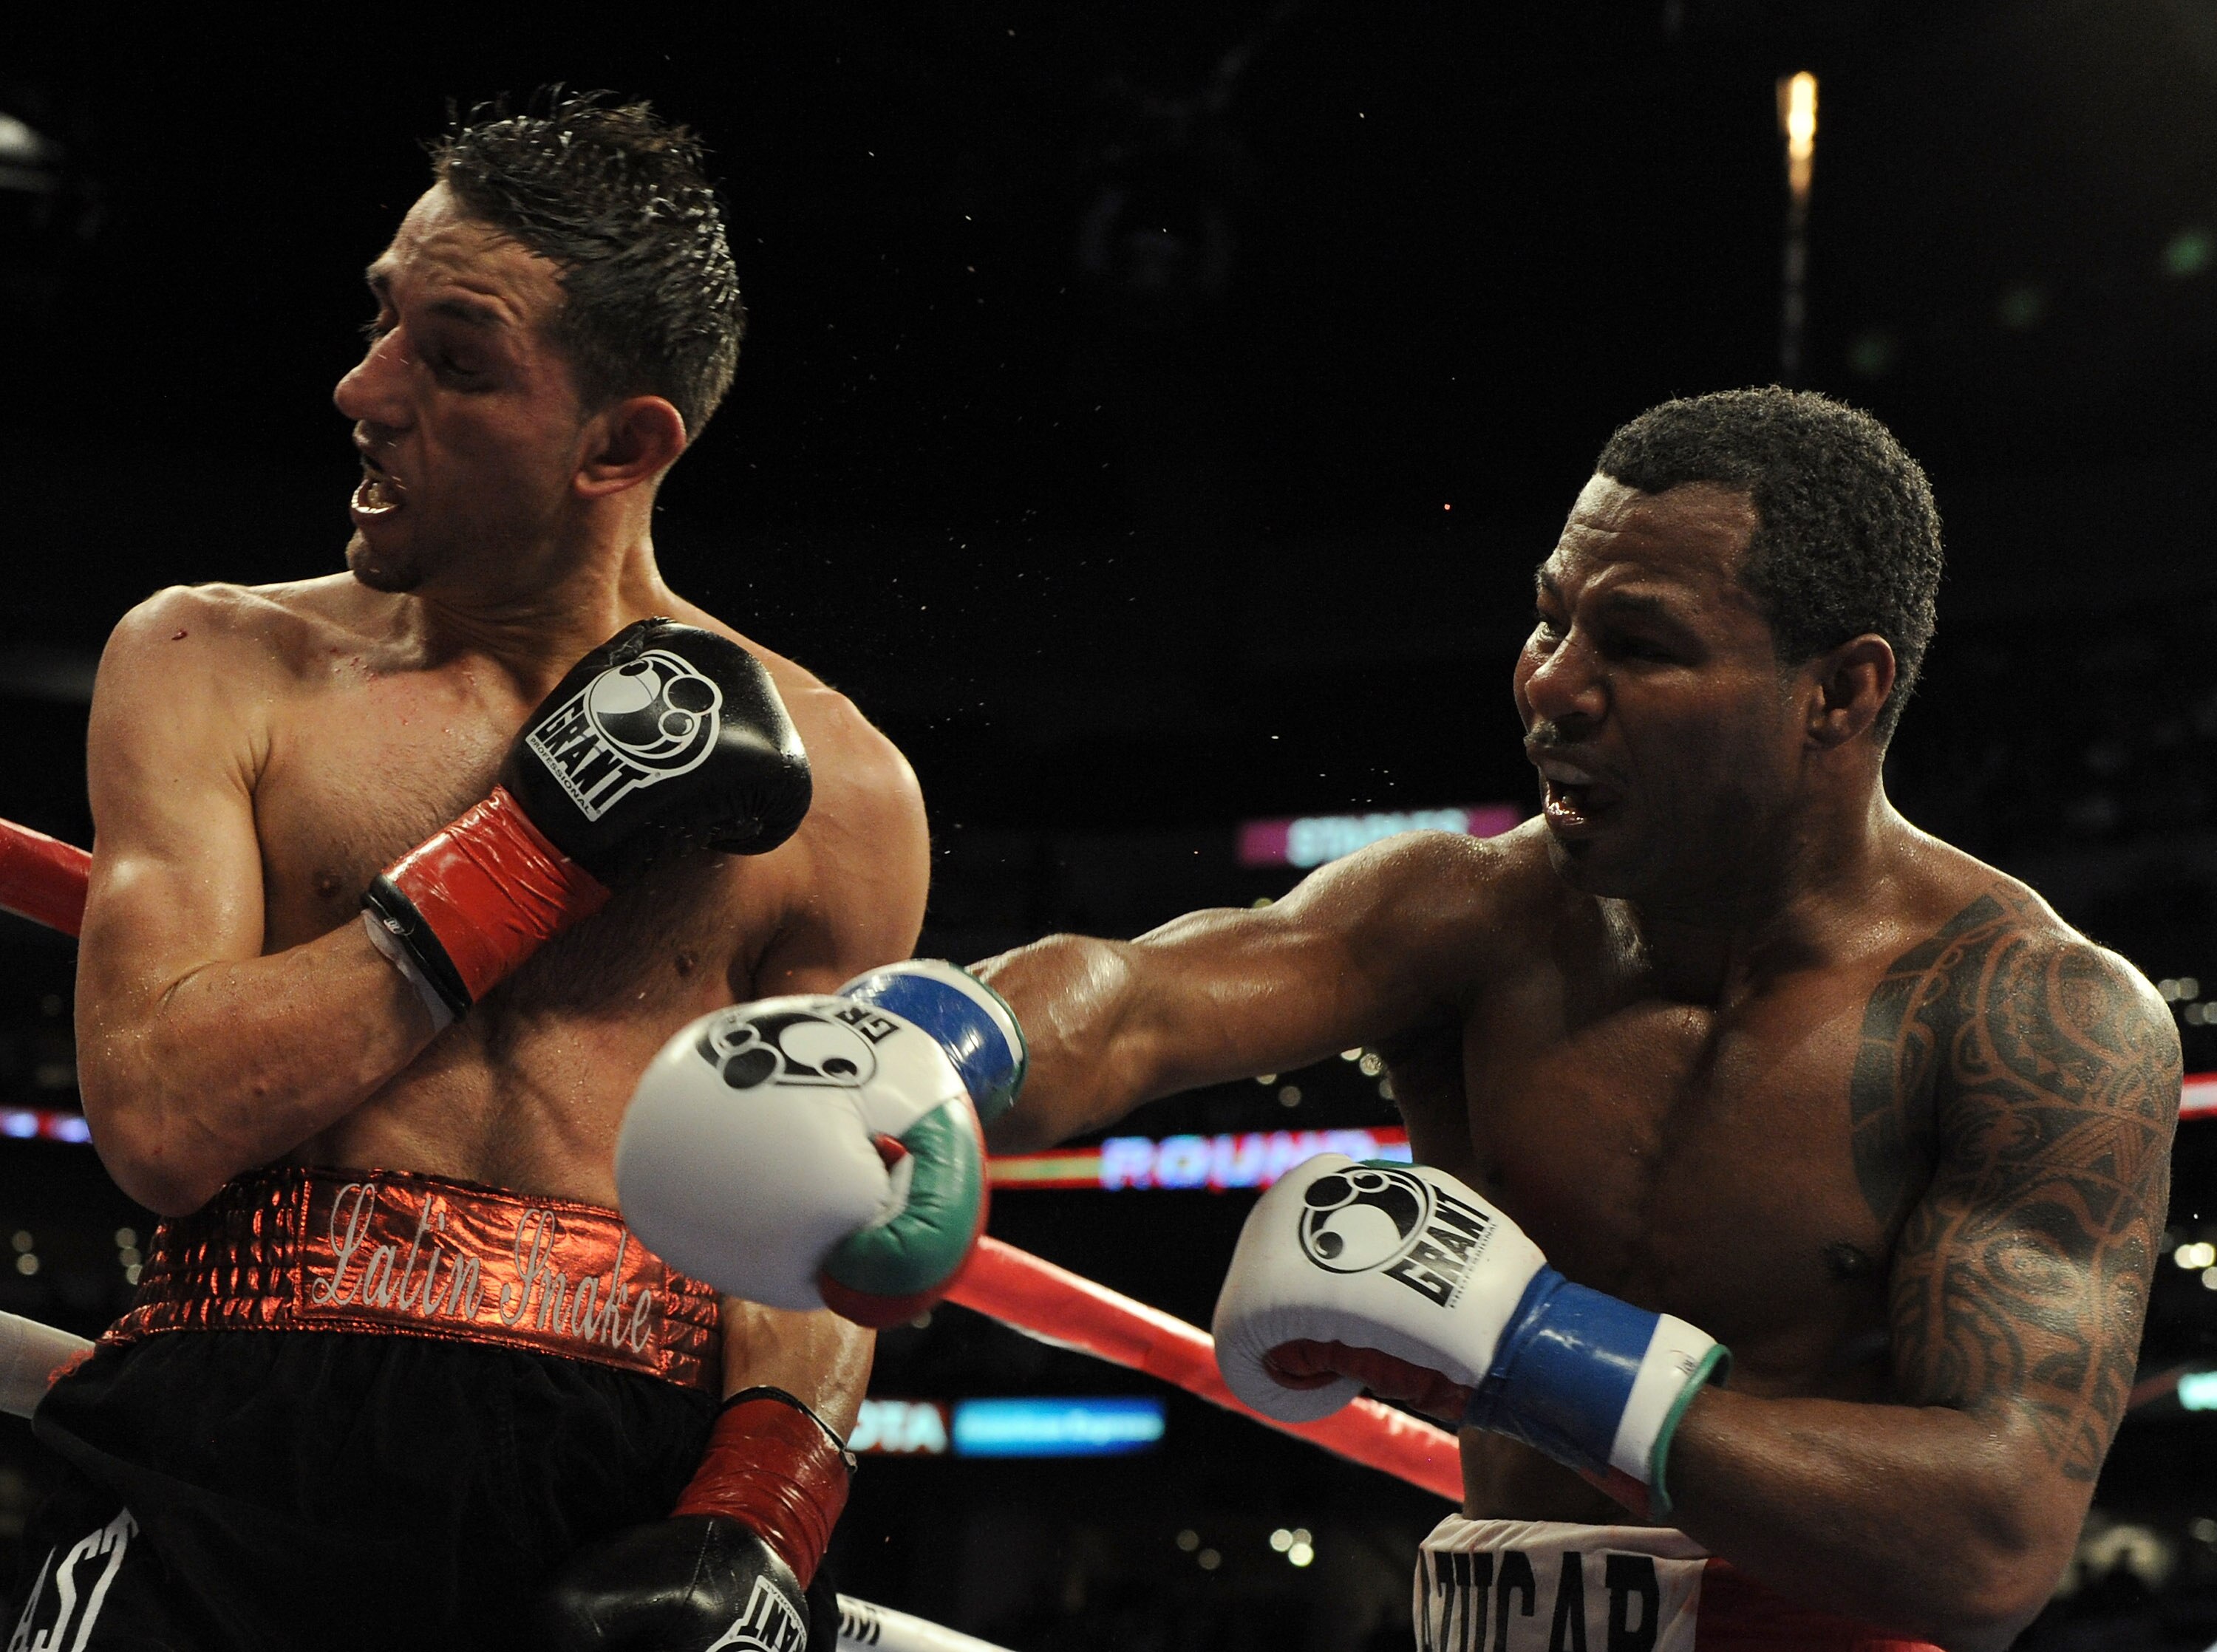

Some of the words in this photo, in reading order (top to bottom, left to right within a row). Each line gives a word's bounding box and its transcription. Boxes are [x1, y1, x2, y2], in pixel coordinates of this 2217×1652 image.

[529, 737, 593, 814] PROFESSIONAL
[535, 692, 651, 813] GRANT
[311, 1182, 484, 1320] Latin
[499, 1208, 652, 1354] Snake
[1383, 1183, 1490, 1308] GRANT
